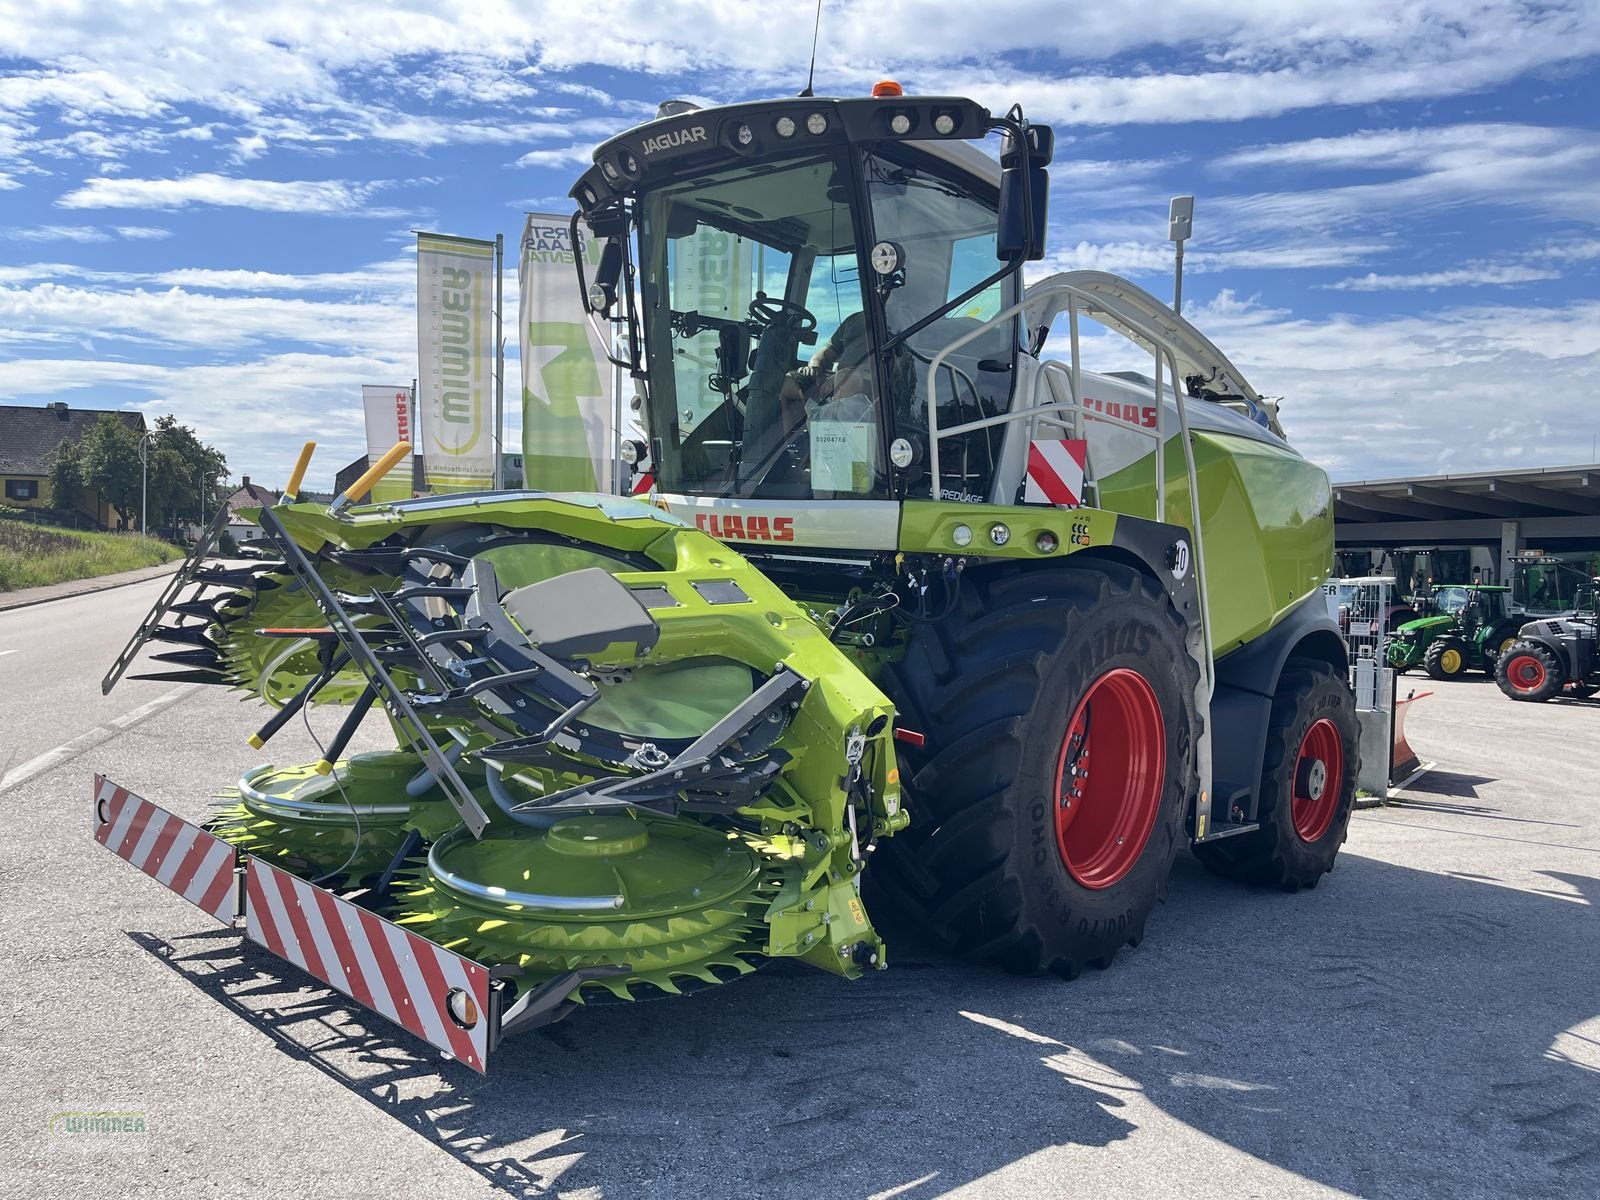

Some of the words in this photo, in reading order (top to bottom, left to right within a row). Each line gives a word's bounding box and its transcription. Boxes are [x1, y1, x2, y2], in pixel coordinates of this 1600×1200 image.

[641, 126, 708, 156] JAGUAR
[928, 487, 984, 503] SREDLAGE
[695, 513, 794, 542] CLAAS
